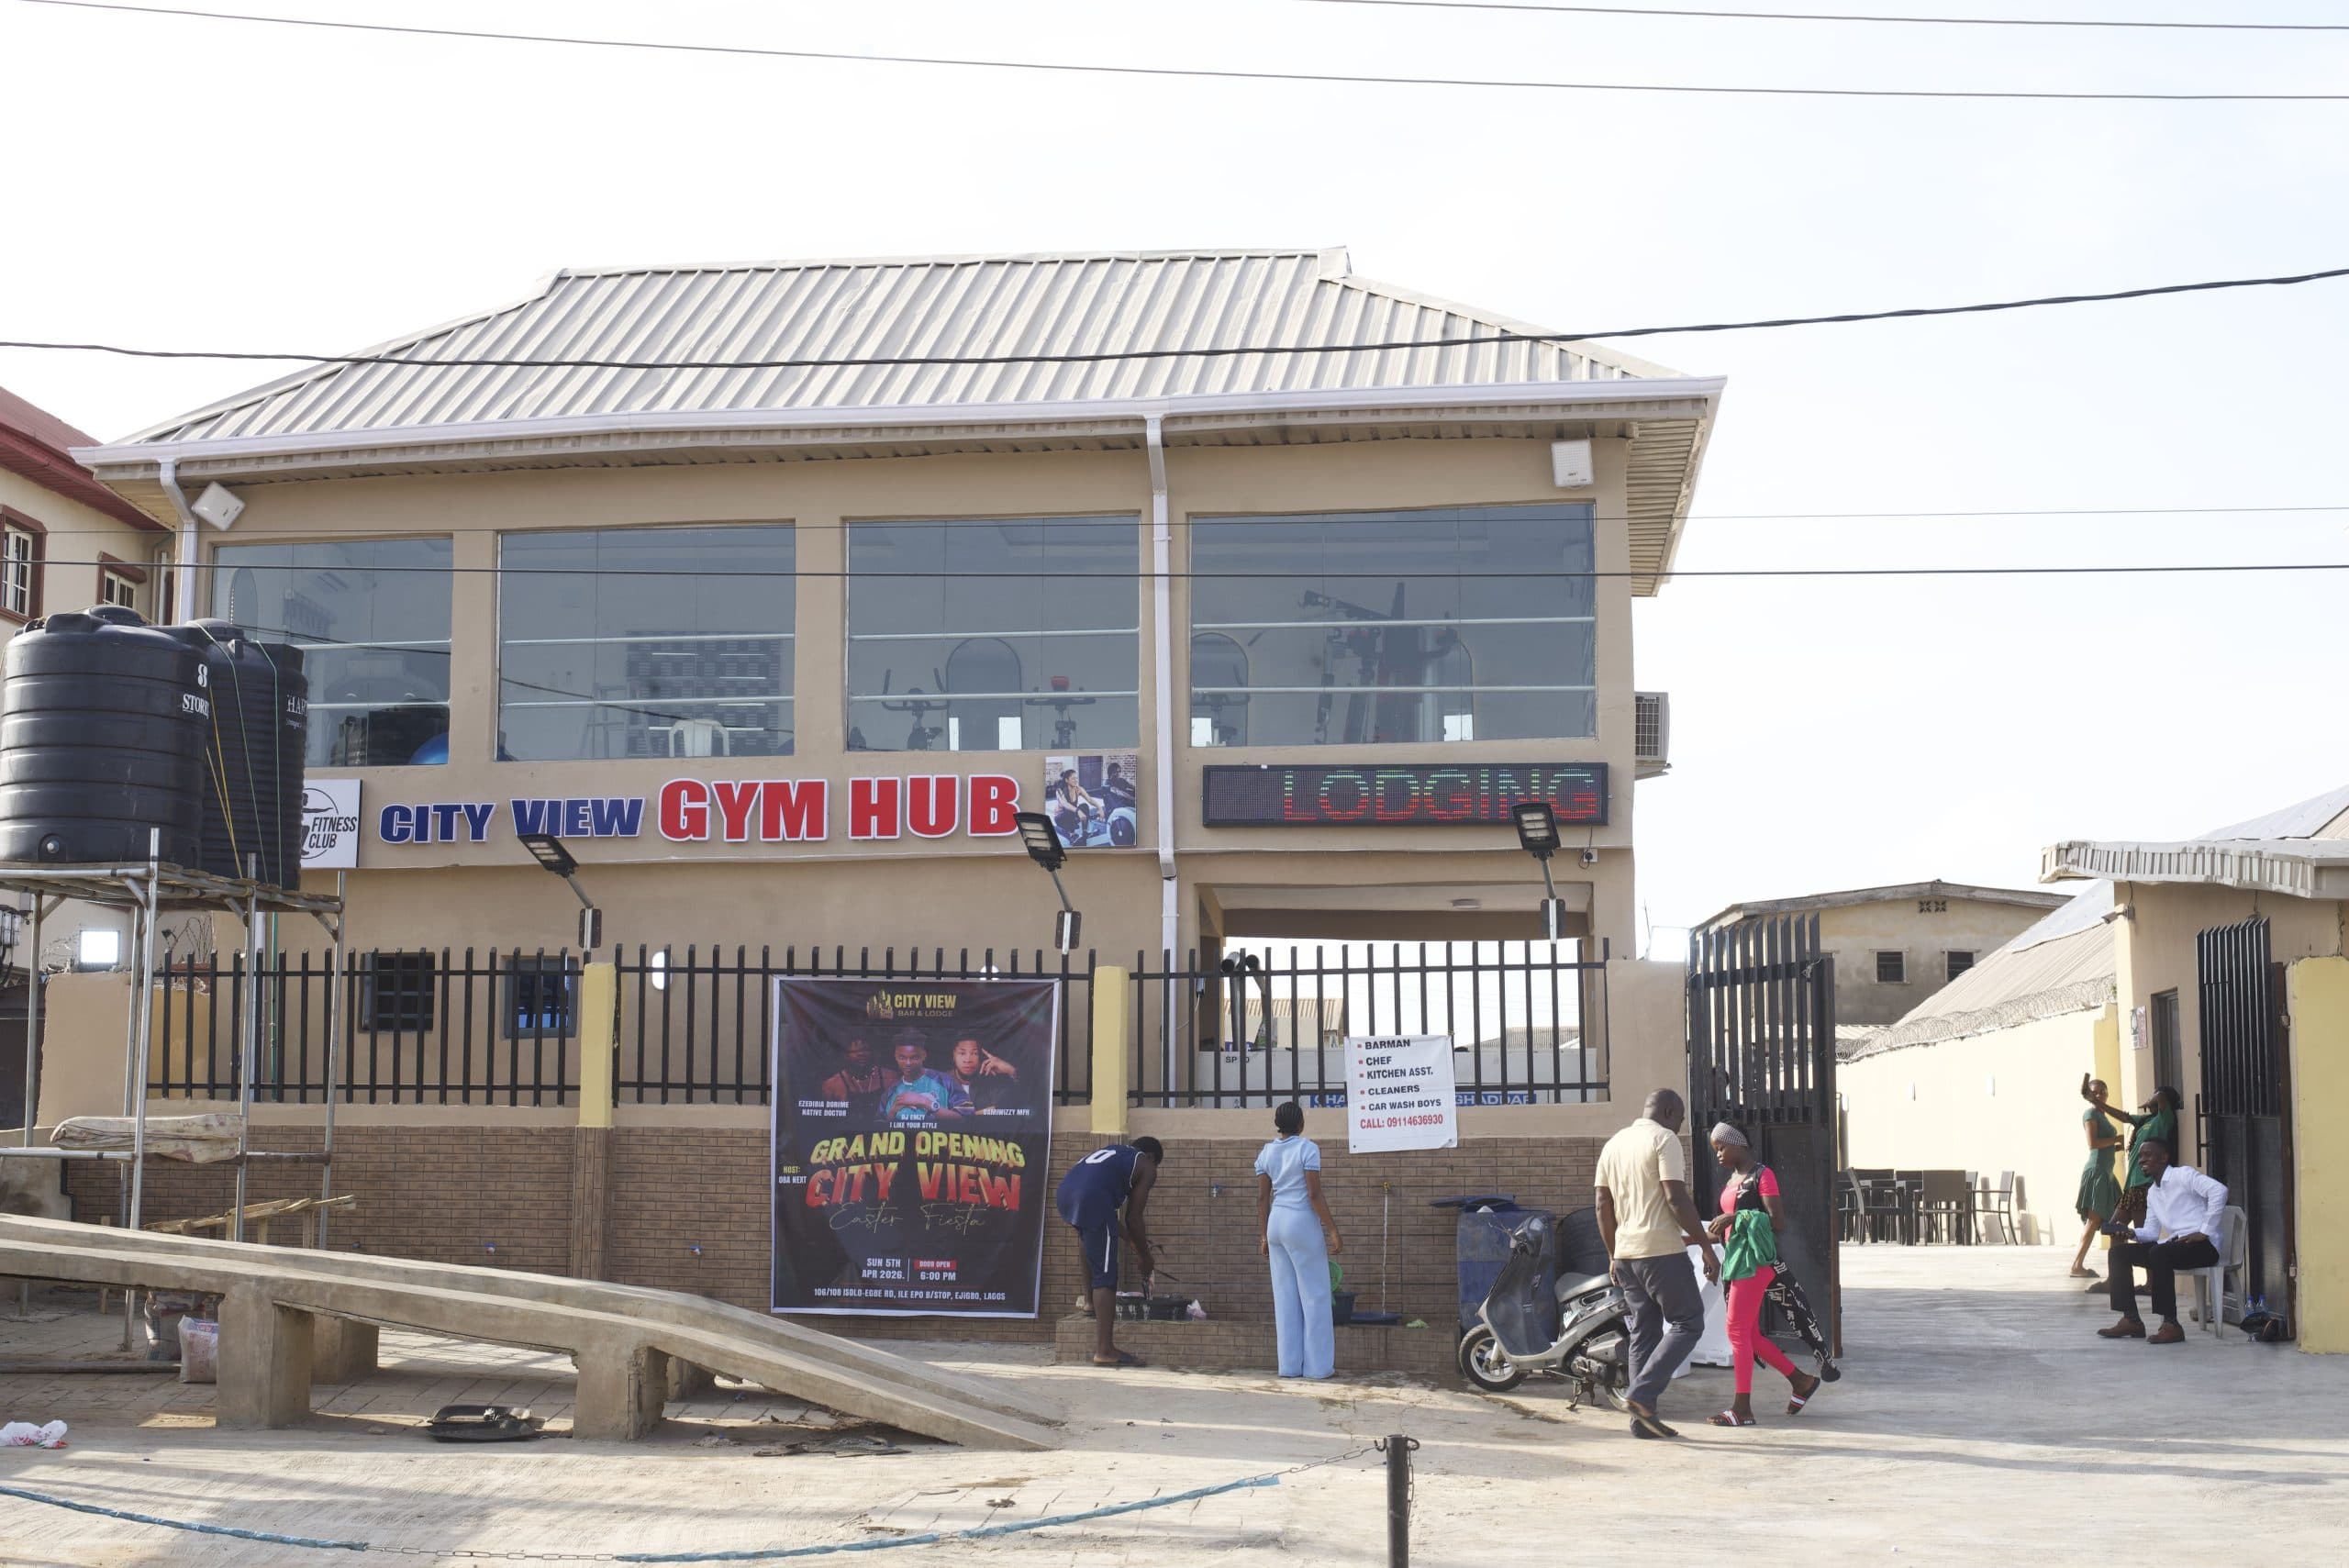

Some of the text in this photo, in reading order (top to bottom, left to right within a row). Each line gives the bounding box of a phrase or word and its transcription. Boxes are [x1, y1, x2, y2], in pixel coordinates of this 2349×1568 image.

[1284, 768, 1598, 820] LODGING
[379, 773, 1019, 844] CITY VIEW GYM HUB
[311, 816, 357, 832] FITNESS
[308, 833, 338, 849] CLUB
[894, 994, 956, 1009] CITY VIEW
[1364, 1039, 1411, 1051] BARMAN
[1365, 1056, 1392, 1066] CHEF
[1366, 1066, 1433, 1080] KITCHEN ASST.
[1368, 1084, 1420, 1096] CLEANERS
[1368, 1099, 1442, 1111] CAR WASH BOYS
[1360, 1114, 1443, 1129] CALL: 09114636930
[809, 1131, 1026, 1168] GRAND OPENING
[783, 1165, 801, 1174] HOST:
[792, 1175, 807, 1184] NEXT
[806, 1161, 1021, 1211] CITY VIEW
[829, 1201, 987, 1236] Easter Fiesta
[866, 1257, 901, 1267] SUN 5TH
[862, 1269, 905, 1279] APR 2026.
[920, 1271, 956, 1281] 6:00 PM
[897, 1290, 908, 1298] ILE
[910, 1290, 924, 1299] EPO
[984, 1292, 1006, 1301] LAGOS
